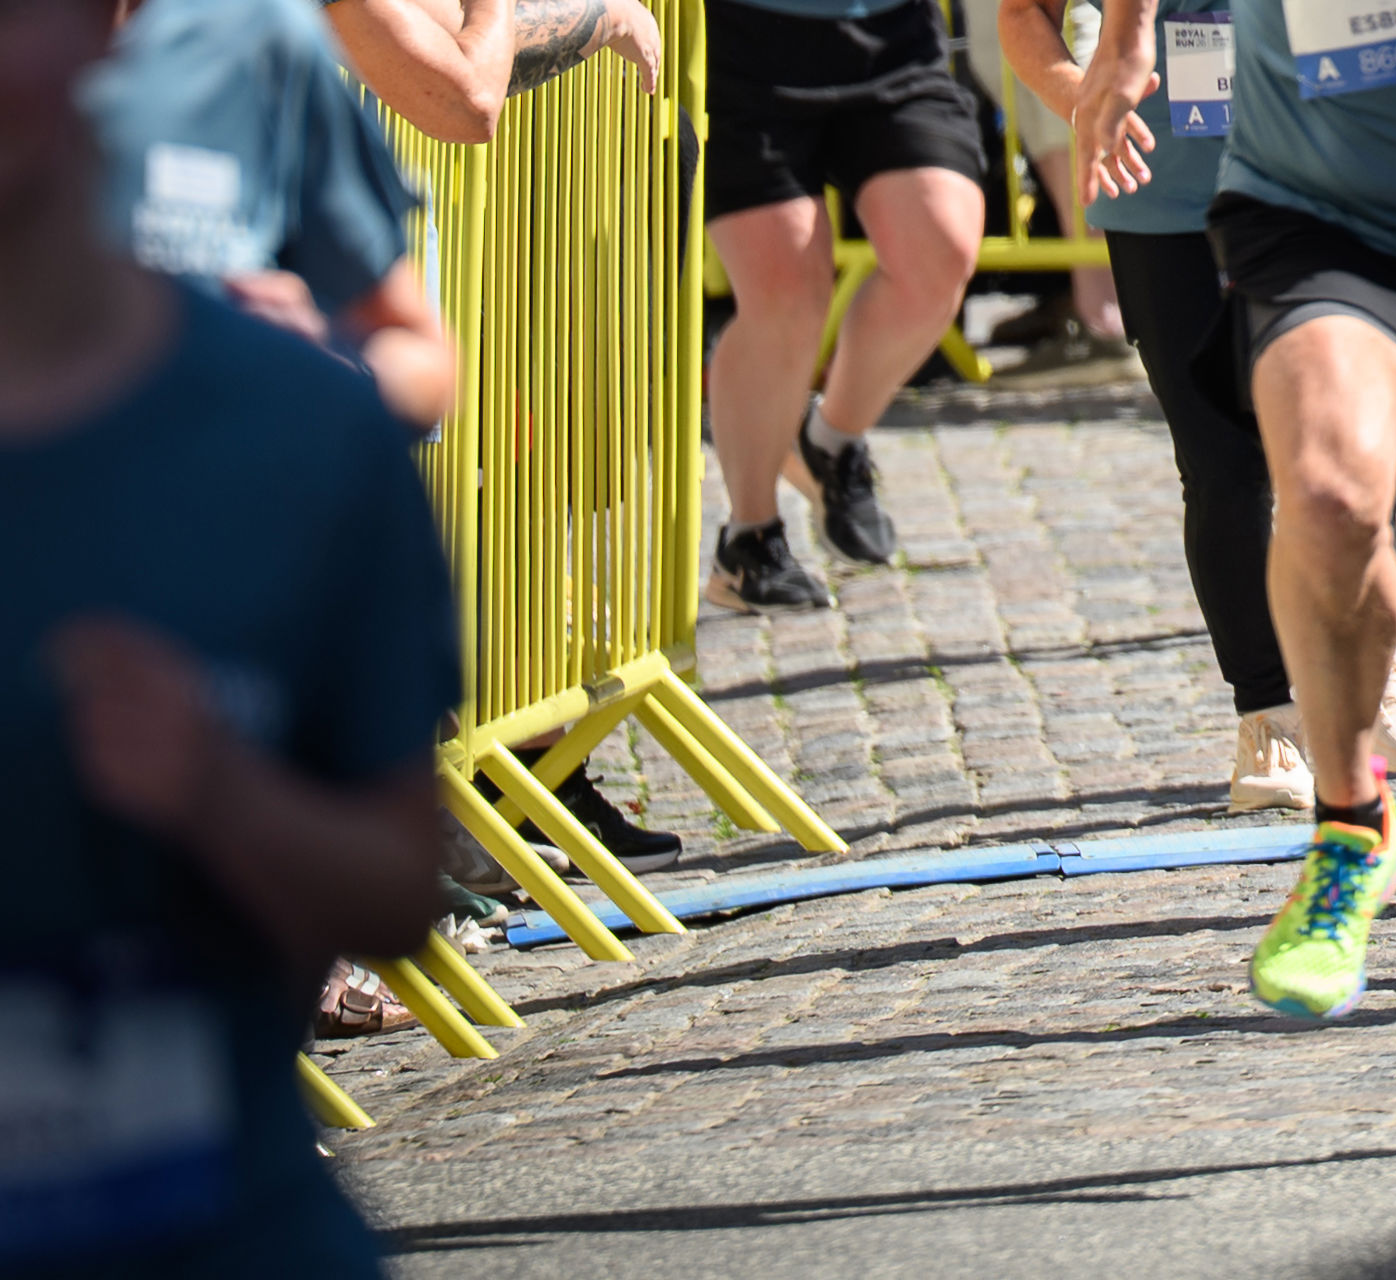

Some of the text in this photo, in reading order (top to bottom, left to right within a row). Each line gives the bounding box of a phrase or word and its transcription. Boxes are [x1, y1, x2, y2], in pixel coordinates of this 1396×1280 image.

[1175, 29, 1206, 39] ROYAL
[1318, 56, 1341, 81] A
[1188, 105, 1204, 125] A
